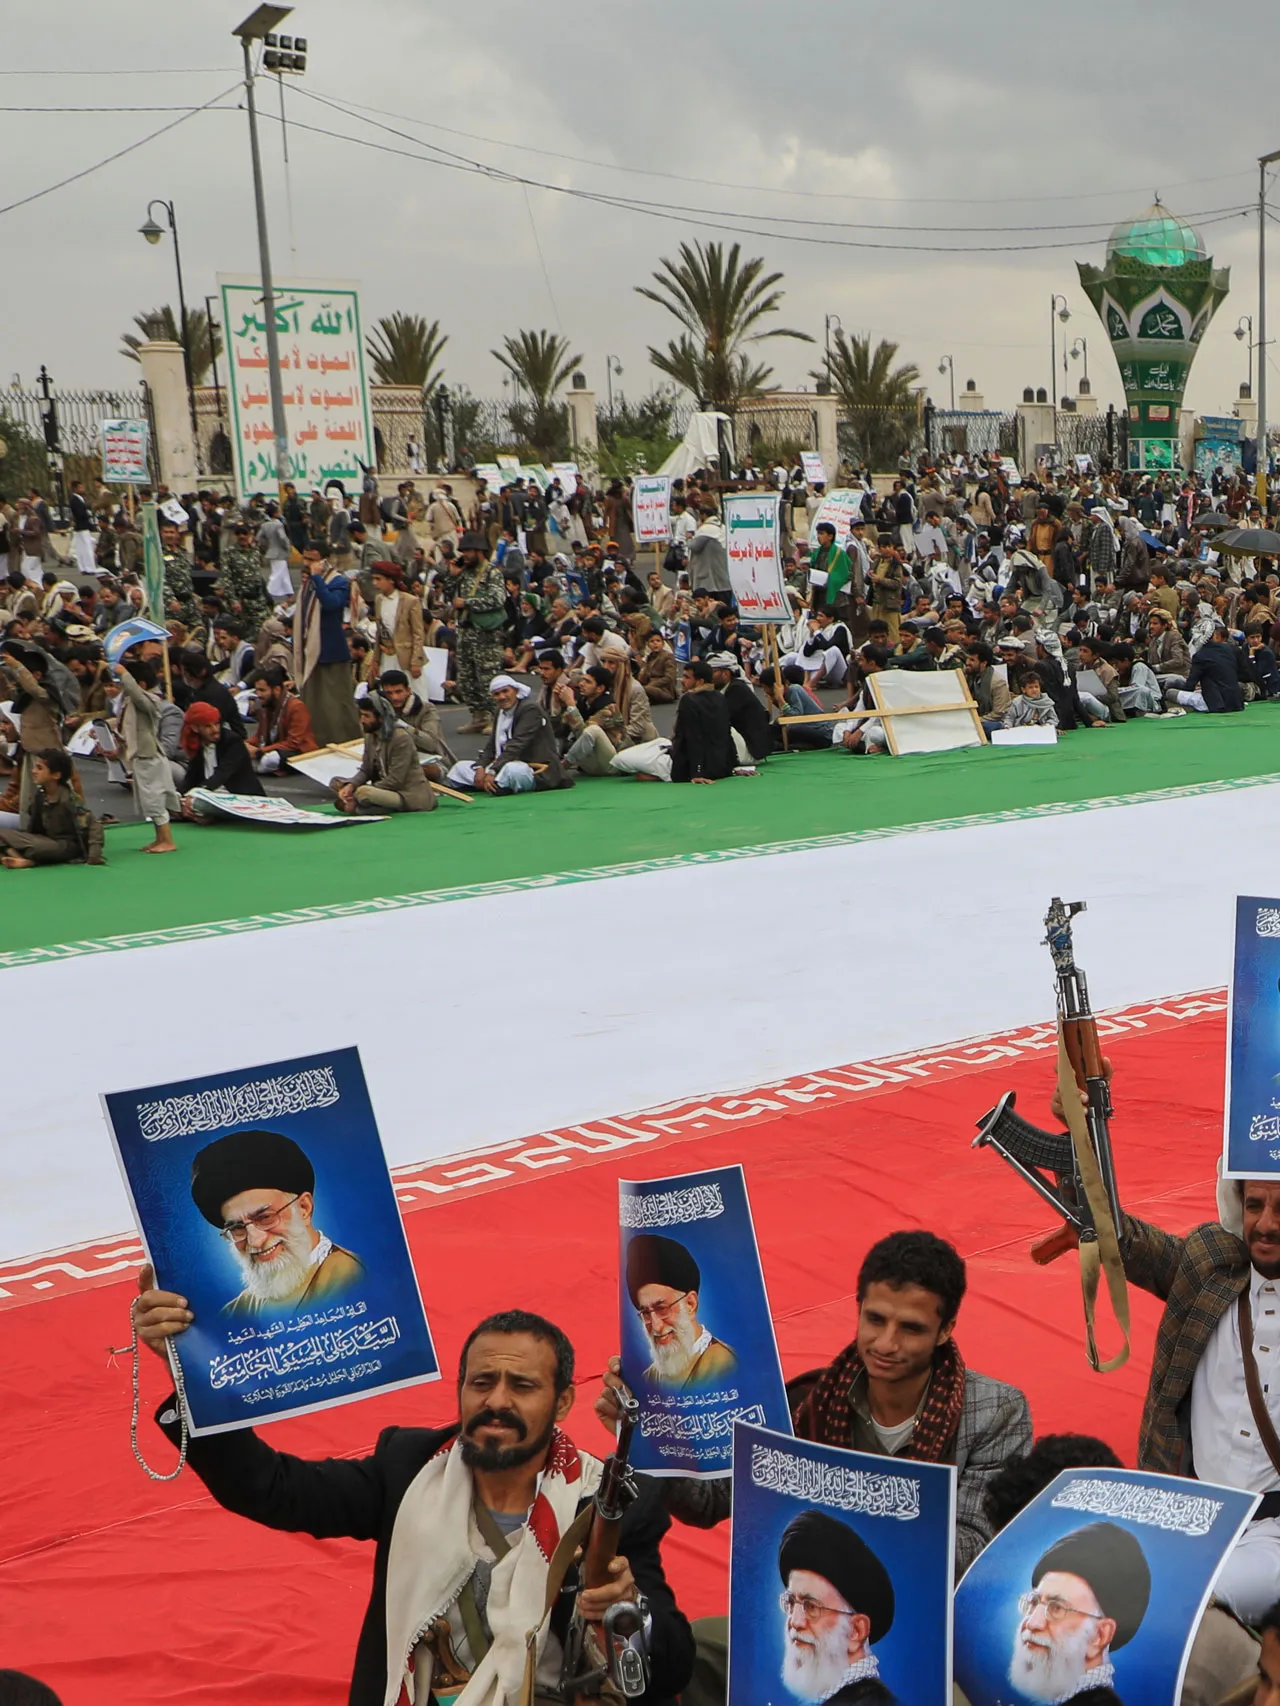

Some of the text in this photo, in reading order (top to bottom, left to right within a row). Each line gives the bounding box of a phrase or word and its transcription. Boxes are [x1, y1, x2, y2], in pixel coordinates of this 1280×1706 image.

[307, 301, 352, 335] الله
[304, 346, 357, 376] الموت
[308, 382, 360, 412] الموت
[344, 1315, 400, 1355] السيد
